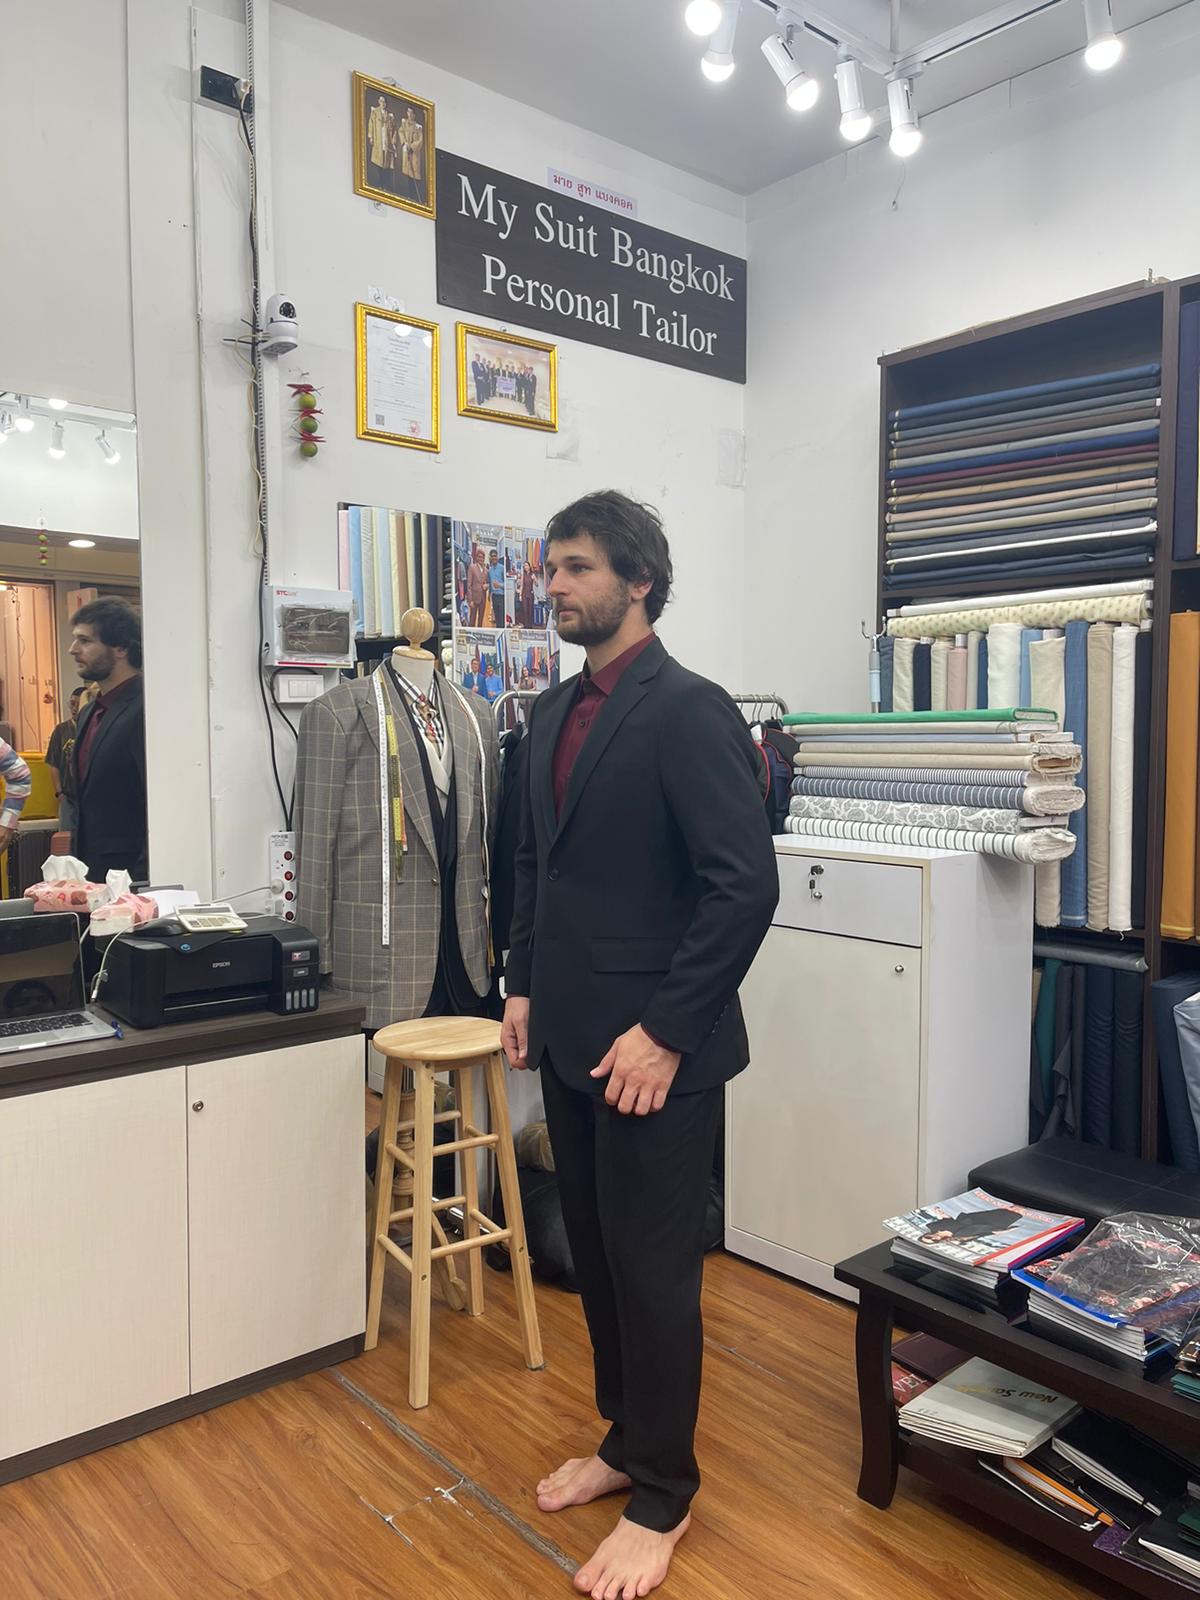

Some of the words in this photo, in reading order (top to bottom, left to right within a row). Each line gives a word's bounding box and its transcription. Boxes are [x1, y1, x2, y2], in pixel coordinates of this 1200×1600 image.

[553, 174, 573, 190] มาย
[457, 173, 518, 240] My
[534, 202, 599, 258] Suit
[610, 226, 735, 302] Bangkok
[481, 253, 622, 330] Personal
[633, 299, 717, 356] Tailor
